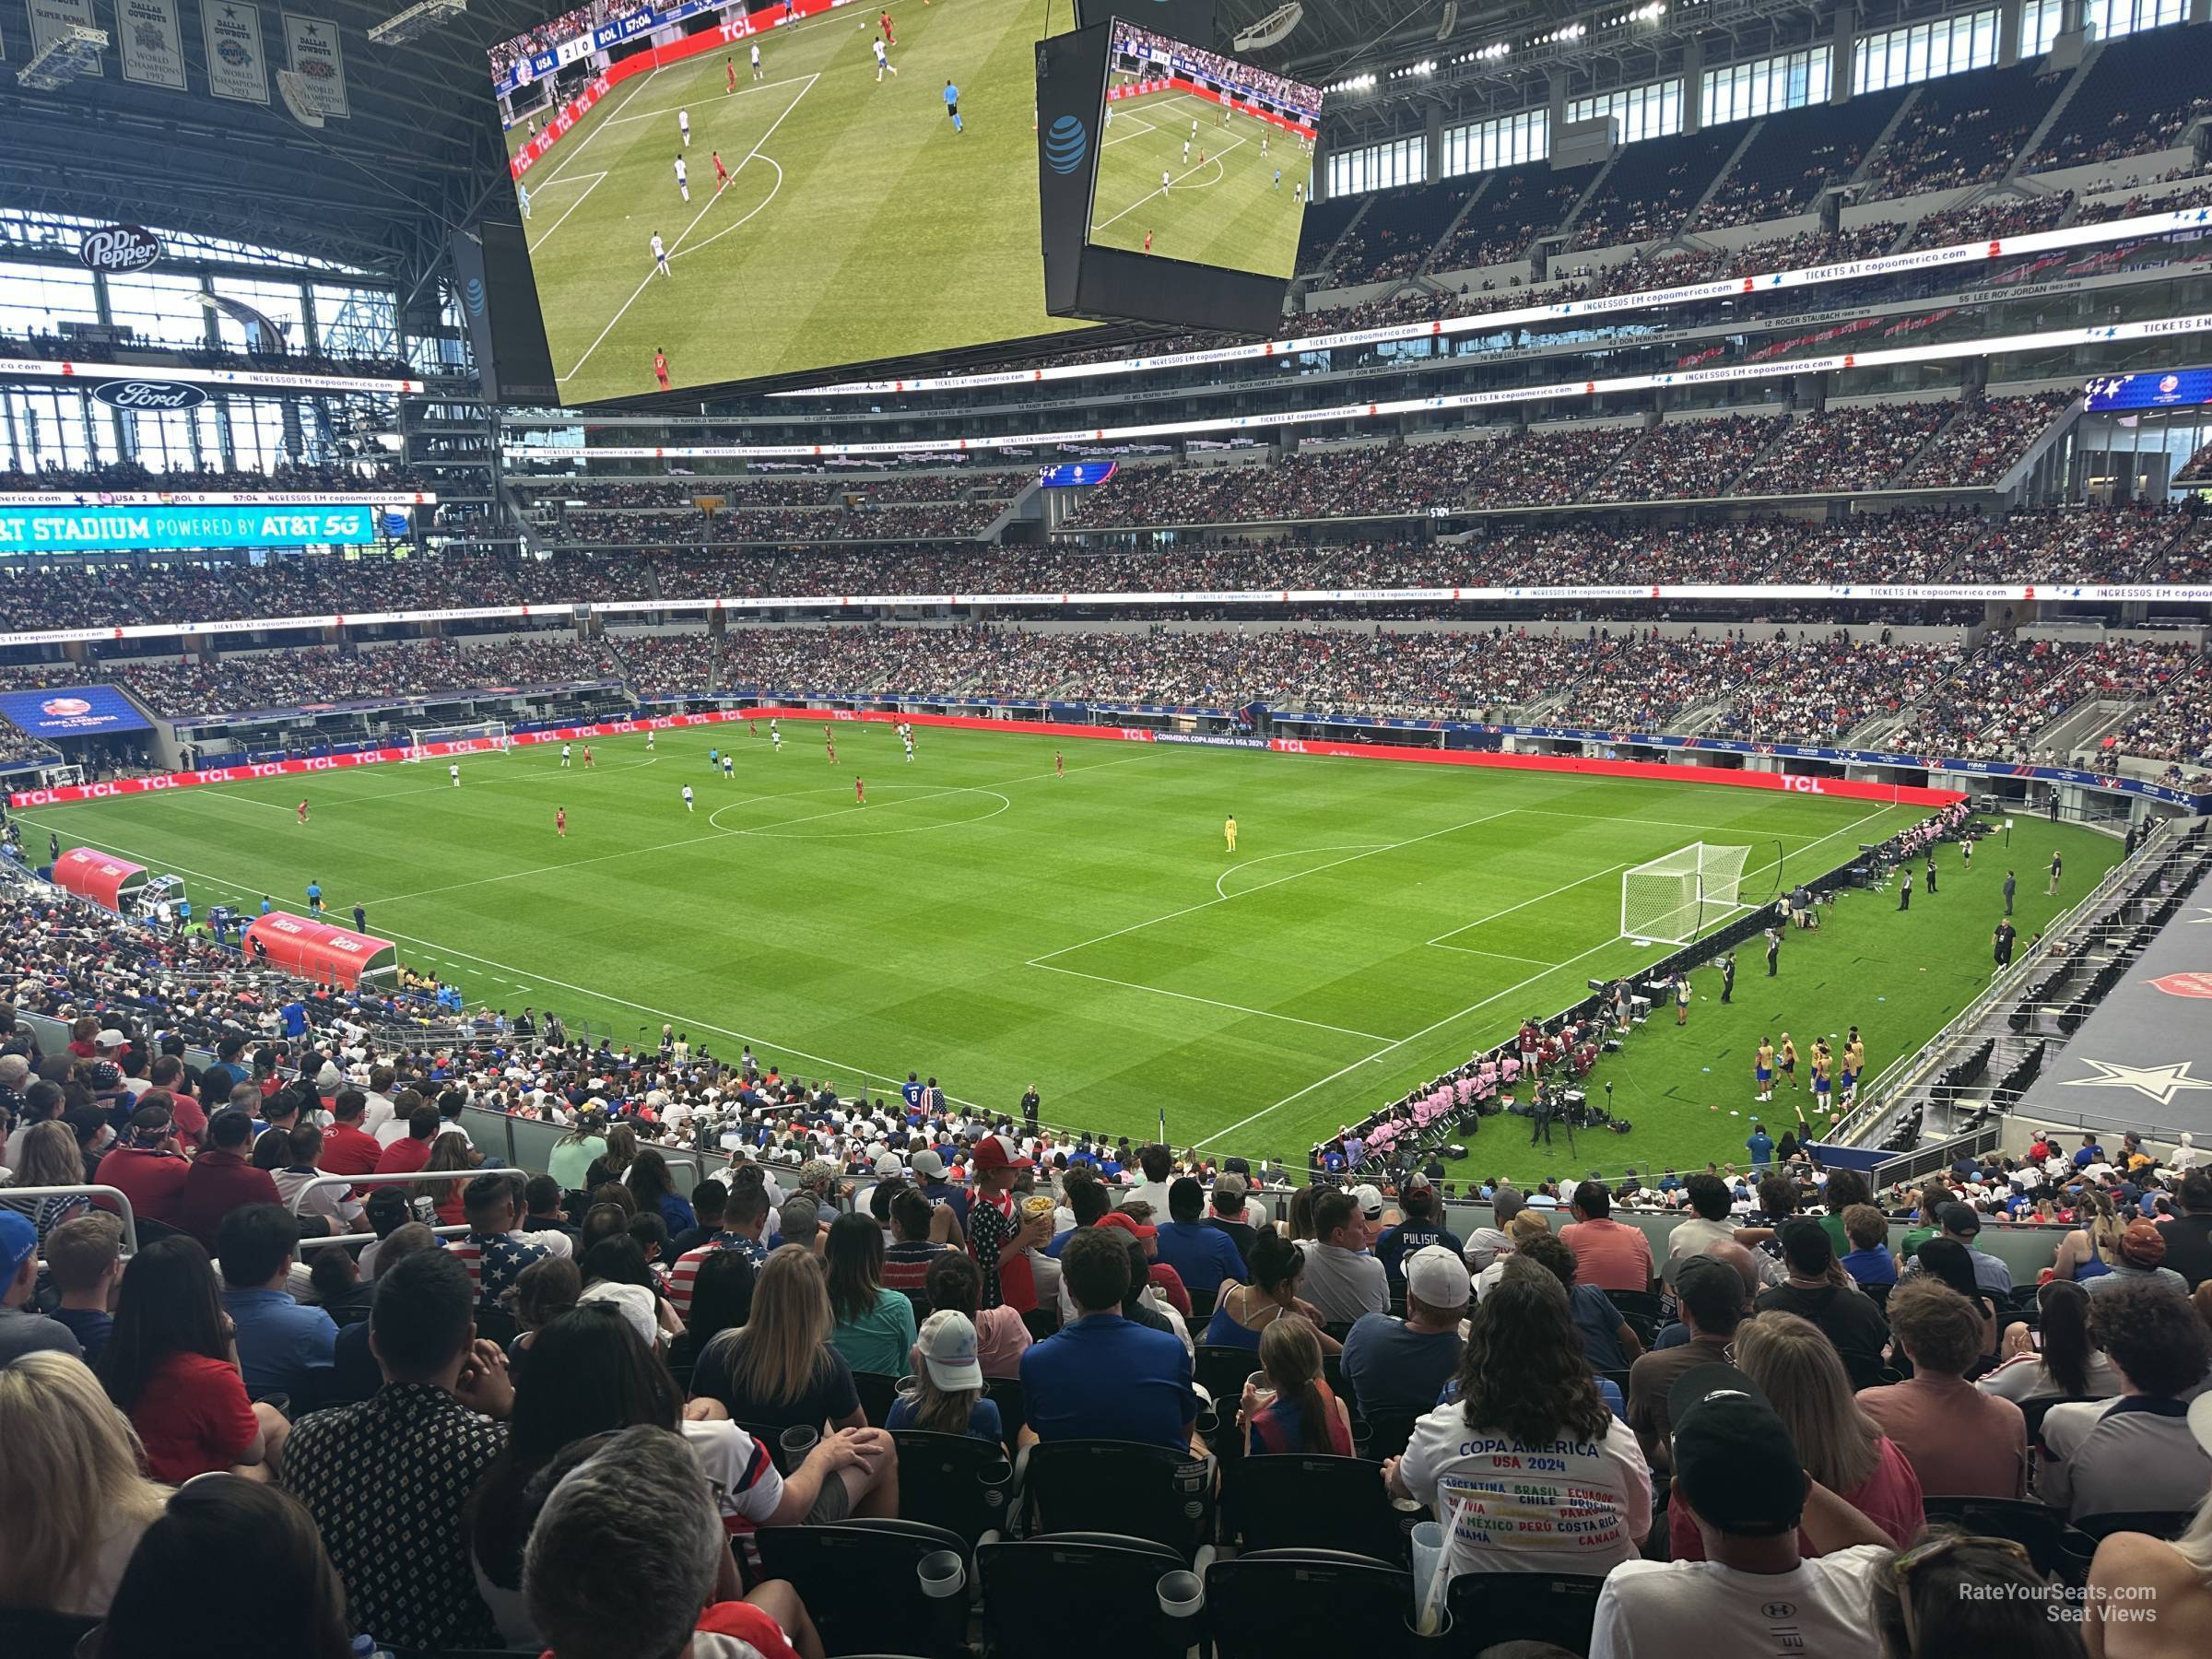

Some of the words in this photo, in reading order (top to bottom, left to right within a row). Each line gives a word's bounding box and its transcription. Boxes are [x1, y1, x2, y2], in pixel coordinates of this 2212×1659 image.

[37, 8, 62, 21] SUPER
[131, 3, 161, 13] DALLAS
[128, 9, 167, 22] COWBOYS
[217, 19, 246, 30] DALLAS
[720, 19, 756, 42] TCL
[215, 28, 251, 40] COWBOYS
[300, 37, 327, 47] DALLAS
[535, 56, 553, 70] USA
[565, 48, 571, 59] 2
[582, 41, 589, 52] 0
[599, 29, 618, 43] BOL
[625, 14, 652, 32] 57:04
[298, 45, 332, 56] COWBOYS
[136, 51, 170, 65] WORLD
[127, 58, 181, 75] CHAMPIONS
[223, 67, 253, 79] WORLD
[146, 71, 165, 81] 1992
[214, 76, 263, 89] CHAMPIONS
[305, 84, 334, 94] WORLD
[513, 150, 533, 175] TCL
[535, 131, 554, 154] TCL
[556, 114, 573, 135] TCL
[576, 95, 593, 116] TCL
[594, 77, 611, 99] TCL
[114, 230, 140, 248] Dr
[84, 231, 156, 269] Pepper
[1805, 266, 1846, 280] TICKETS
[1849, 264, 1862, 275] AT
[1865, 249, 1967, 271] copaamerica.com
[1974, 292, 1989, 301] LEE
[1991, 288, 2010, 300] ROY
[2011, 285, 2047, 297] JORDAN
[1583, 298, 1629, 311] INGRESSOS
[1631, 296, 1644, 304] EM
[1775, 316, 1802, 326] ROGER
[1802, 312, 1841, 324] STAUBACH
[2144, 320, 2192, 333] TICKETS
[2196, 318, 2211, 327] EN
[1309, 337, 1337, 347] TICKETS
[1339, 335, 1347, 344] AT
[1635, 334, 1664, 344] PERKINS
[1149, 356, 1183, 366] INGRESSOS
[1369, 367, 1396, 376] MEREDITH
[1686, 371, 1730, 381] INGRESSOS
[1733, 369, 1746, 377] EM
[249, 374, 296, 384] INGRESSOS
[116, 382, 187, 407] Ford
[1459, 394, 1488, 404] TICKETS
[33, 517, 150, 541] STADIUM
[157, 519, 230, 536] POWERED
[238, 519, 254, 535] BY
[261, 516, 320, 536] AT&T
[323, 515, 360, 536] 5G
[1870, 588, 1904, 596] TICKETS
[2097, 589, 2152, 597] INGRESSOS
[2157, 589, 2171, 597] EM
[832, 710, 854, 721] TCL
[1122, 729, 1147, 742] TCL
[1158, 734, 1190, 743] CONMEBOL
[1249, 739, 1263, 747] 2024
[1278, 740, 1308, 753] TCL
[15, 792, 60, 806] TCL
[79, 782, 121, 797] TCL
[139, 776, 180, 790] TCL
[196, 771, 234, 783] TCL
[251, 760, 287, 777] TCL
[302, 757, 337, 771] TCL
[352, 750, 386, 764] TCL
[400, 745, 432, 758] TCL
[446, 740, 477, 752] TCL
[532, 731, 560, 742] TCL
[572, 725, 601, 737] TCL
[611, 720, 639, 732] TCL
[649, 717, 675, 728] TCL
[686, 713, 710, 724] TCL
[720, 710, 743, 721] TCL
[1781, 775, 1824, 794] TCL
[911, 1090, 917, 1102] 8
[1403, 1232, 1440, 1245] PULISIC
[1460, 1440, 1509, 1456] COPA
[1493, 1456, 1522, 1469] USA
[1527, 1457, 1566, 1472] 2024
[1446, 1478, 1506, 1493] ARGENTINA
[1514, 1485, 1560, 1497] BRASIL
[1568, 1488, 1614, 1503] ECUADOR
[1449, 1497, 1486, 1514] BOIVIA
[1519, 1495, 1556, 1506] CHILE
[1467, 1515, 1513, 1532] MÉXICO
[1518, 1518, 1552, 1532] PERÚ
[1557, 1520, 1597, 1533] COSTA
[1597, 1515, 1619, 1530] RICA
